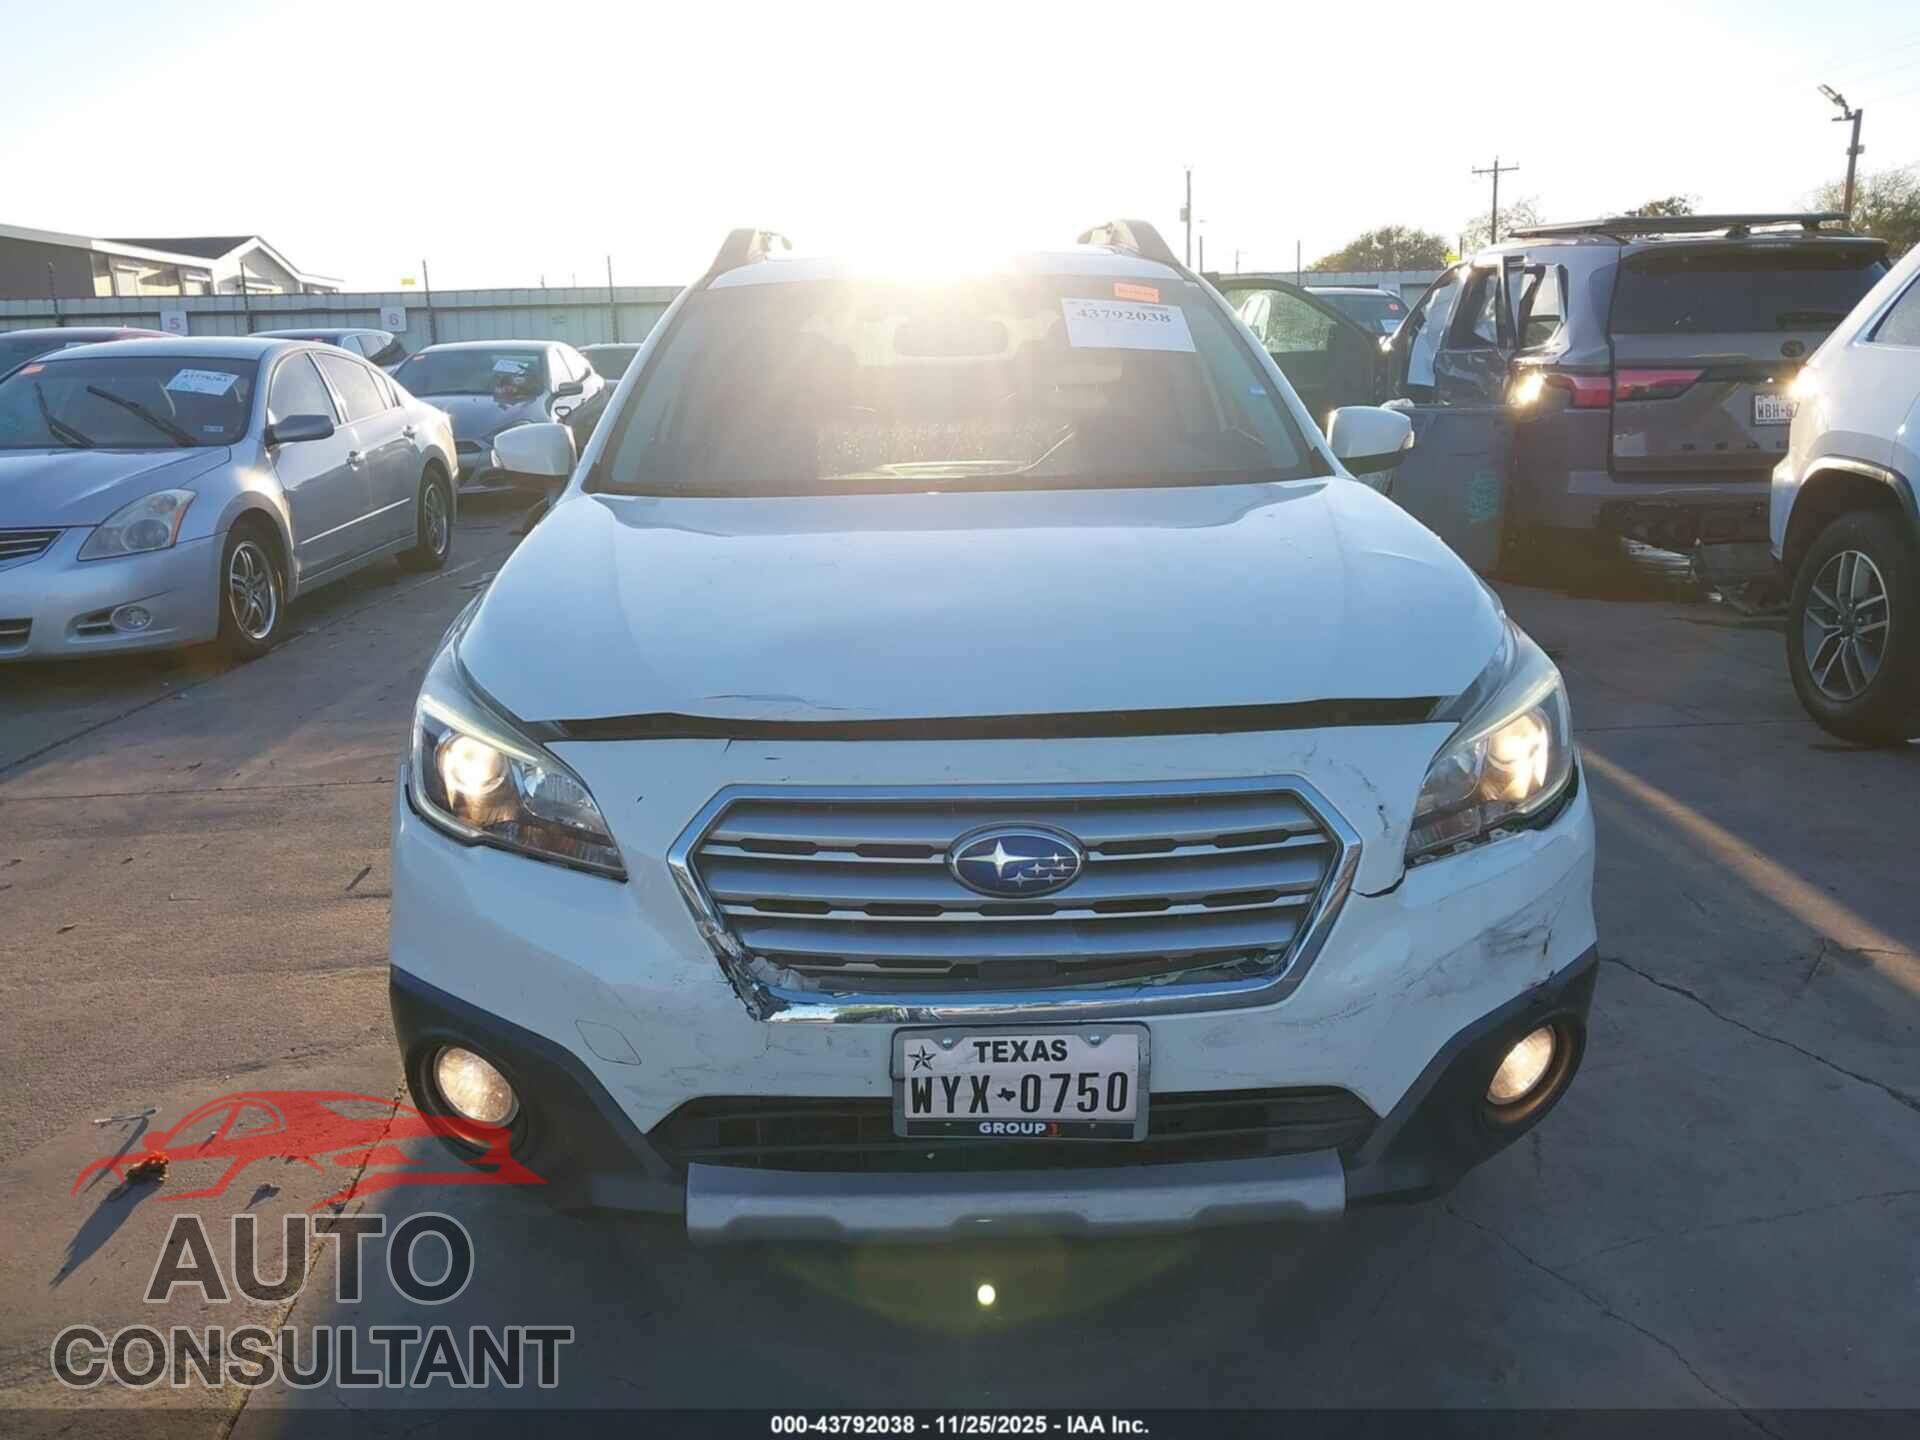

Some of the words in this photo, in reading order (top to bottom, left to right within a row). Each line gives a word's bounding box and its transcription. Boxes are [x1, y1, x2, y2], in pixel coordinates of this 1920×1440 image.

[1076, 308, 1172, 323] 43792038
[973, 1039, 1068, 1064] TEXAS
[979, 1121, 1046, 1135] GROUP
